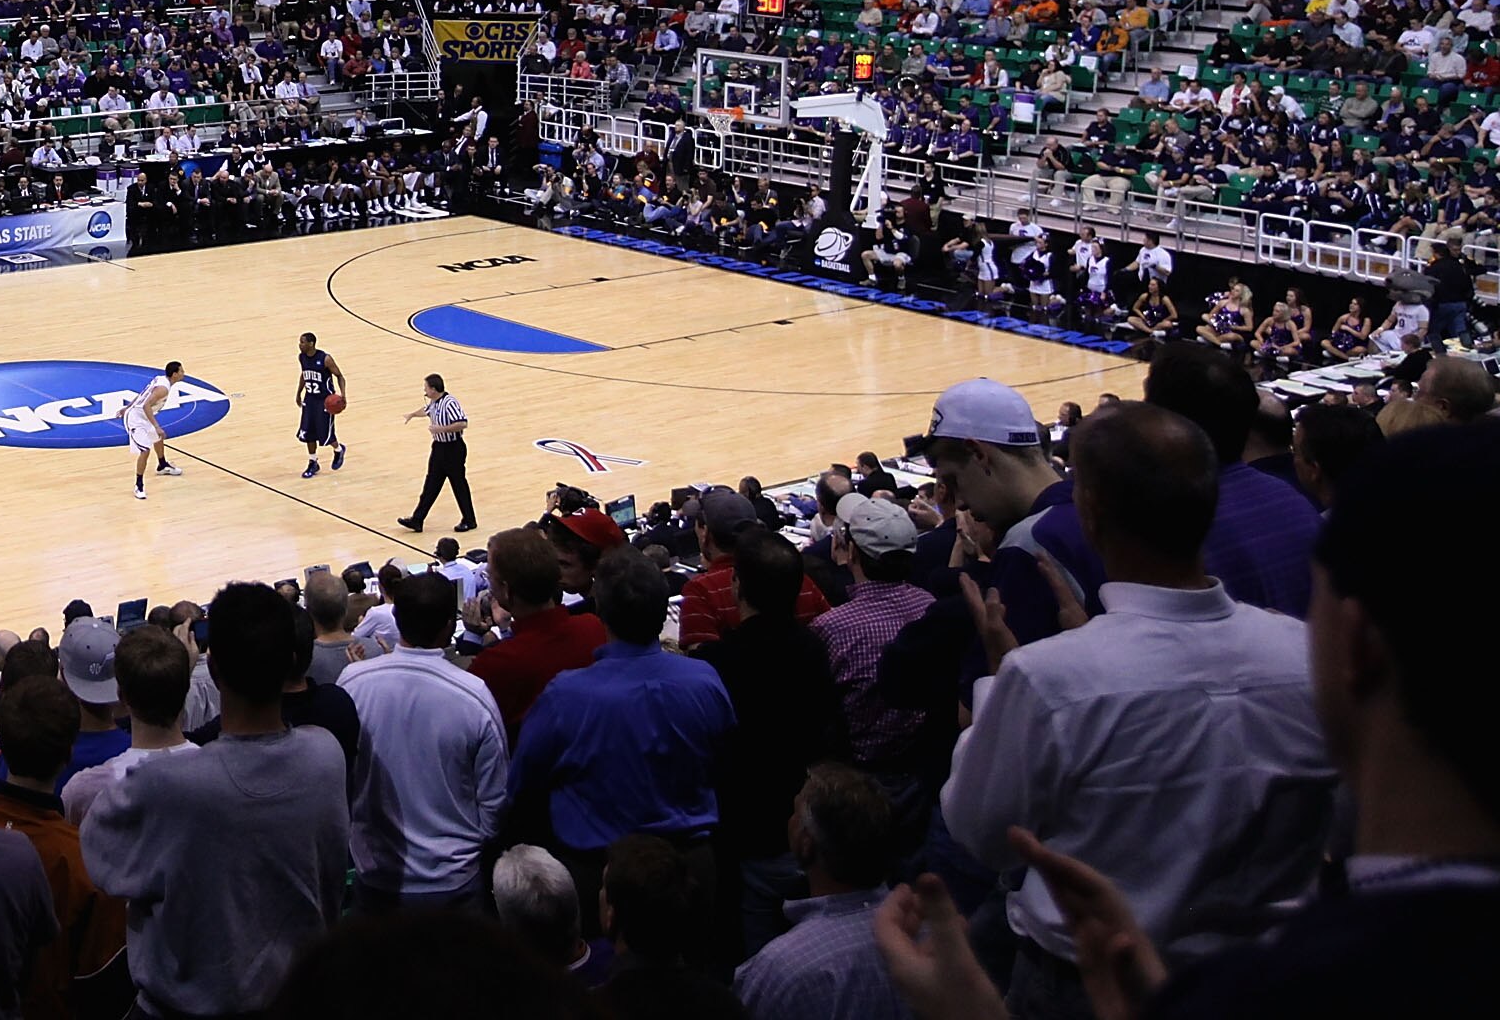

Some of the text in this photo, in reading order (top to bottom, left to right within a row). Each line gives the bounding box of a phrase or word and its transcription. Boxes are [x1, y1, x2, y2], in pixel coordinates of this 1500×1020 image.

[484, 23, 530, 40] CBS
[14, 225, 51, 242] STATE
[88, 223, 111, 233] NCAA
[436, 255, 539, 272] NCAA
[305, 382, 320, 393] 52
